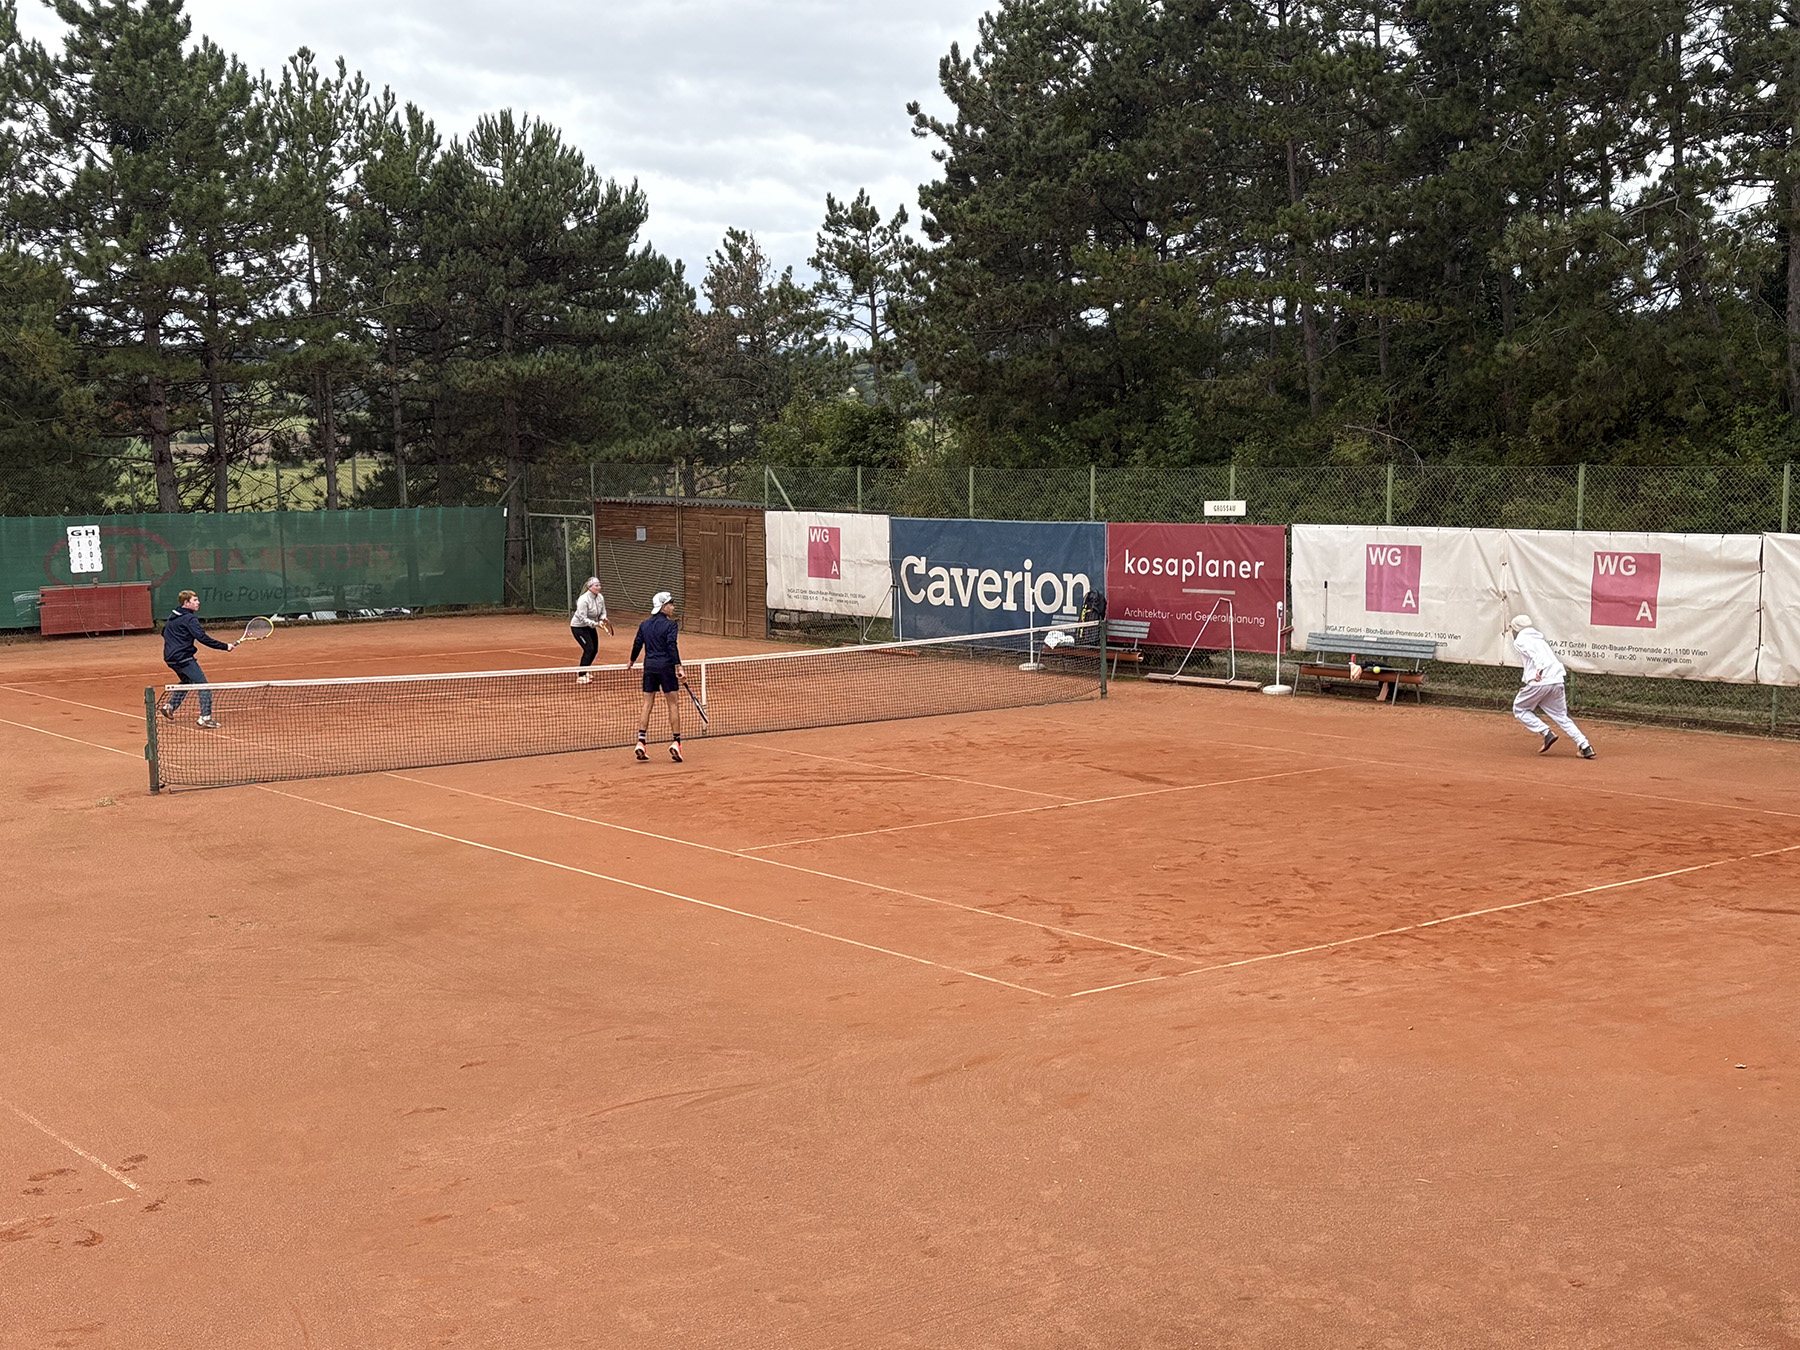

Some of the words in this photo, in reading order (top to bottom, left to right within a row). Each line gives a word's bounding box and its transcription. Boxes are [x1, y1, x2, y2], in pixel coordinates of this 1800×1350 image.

[809, 528, 830, 543] WG
[1125, 549, 1264, 582] kosaplaner
[1368, 547, 1402, 566] WG
[1597, 555, 1637, 576] WG
[831, 561, 839, 575] A
[900, 556, 1091, 614] Caverion
[202, 587, 233, 602] The
[1402, 590, 1416, 608] A
[1124, 607, 1174, 619] Architektur-
[1176, 612, 1192, 621] und
[1194, 611, 1266, 627] Generalplanung
[1636, 601, 1653, 622] A
[1447, 633, 1462, 641] Wien
[1591, 643, 1662, 654] Bloch-Bauer-Promenade
[1675, 648, 1691, 656] 1100
[1691, 648, 1709, 657] Wien
